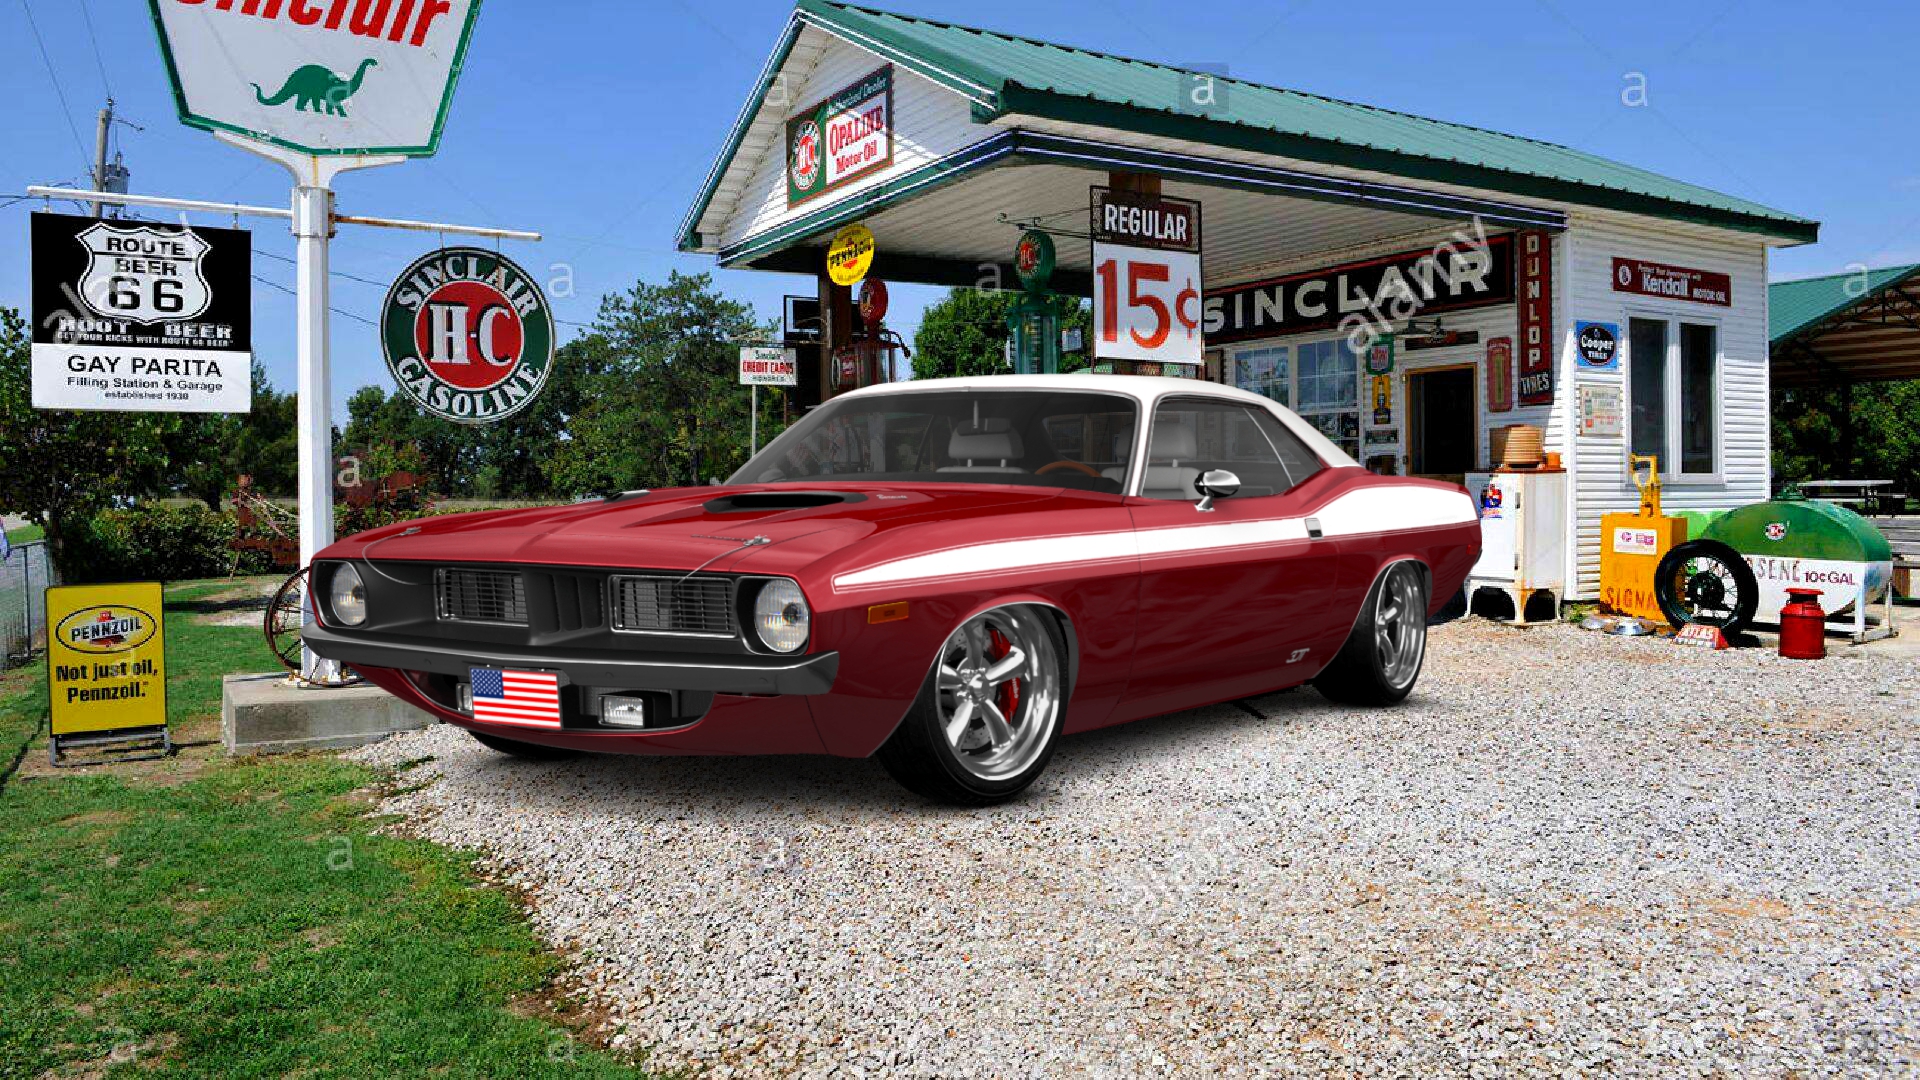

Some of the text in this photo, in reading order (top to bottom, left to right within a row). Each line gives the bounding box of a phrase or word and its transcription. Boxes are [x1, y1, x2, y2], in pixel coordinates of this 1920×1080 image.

[177, 0, 450, 47] cair
[829, 106, 883, 156] OPALINE
[836, 139, 877, 174] Motor Oil
[1104, 203, 1187, 241] REGULAR
[107, 237, 186, 256] ROUTE
[115, 257, 177, 276] BEER
[397, 256, 538, 318] SINCLAIR
[1202, 250, 1490, 333] SINCLAIR
[1642, 272, 1688, 296] Kendall
[1525, 234, 1541, 368] DUNLOP
[106, 334, 134, 343] KICKS
[136, 336, 159, 344] WITH
[161, 337, 190, 346] ROUTE
[164, 322, 233, 339] BEER
[1581, 334, 1614, 351] Cooper
[67, 354, 223, 378] GAY PARITA
[743, 361, 768, 373] CREDIT
[67, 376, 223, 393] Filling Station & Garage
[104, 391, 163, 400] established
[397, 356, 543, 417] GASOLINE
[1521, 371, 1550, 396] TIRES
[1828, 570, 1856, 586] GAL
[1606, 585, 1656, 612] SIGNA
[71, 616, 143, 642] PENNZOIL
[56, 659, 158, 682] Not just oil,
[67, 681, 146, 704] Pennzoil.
